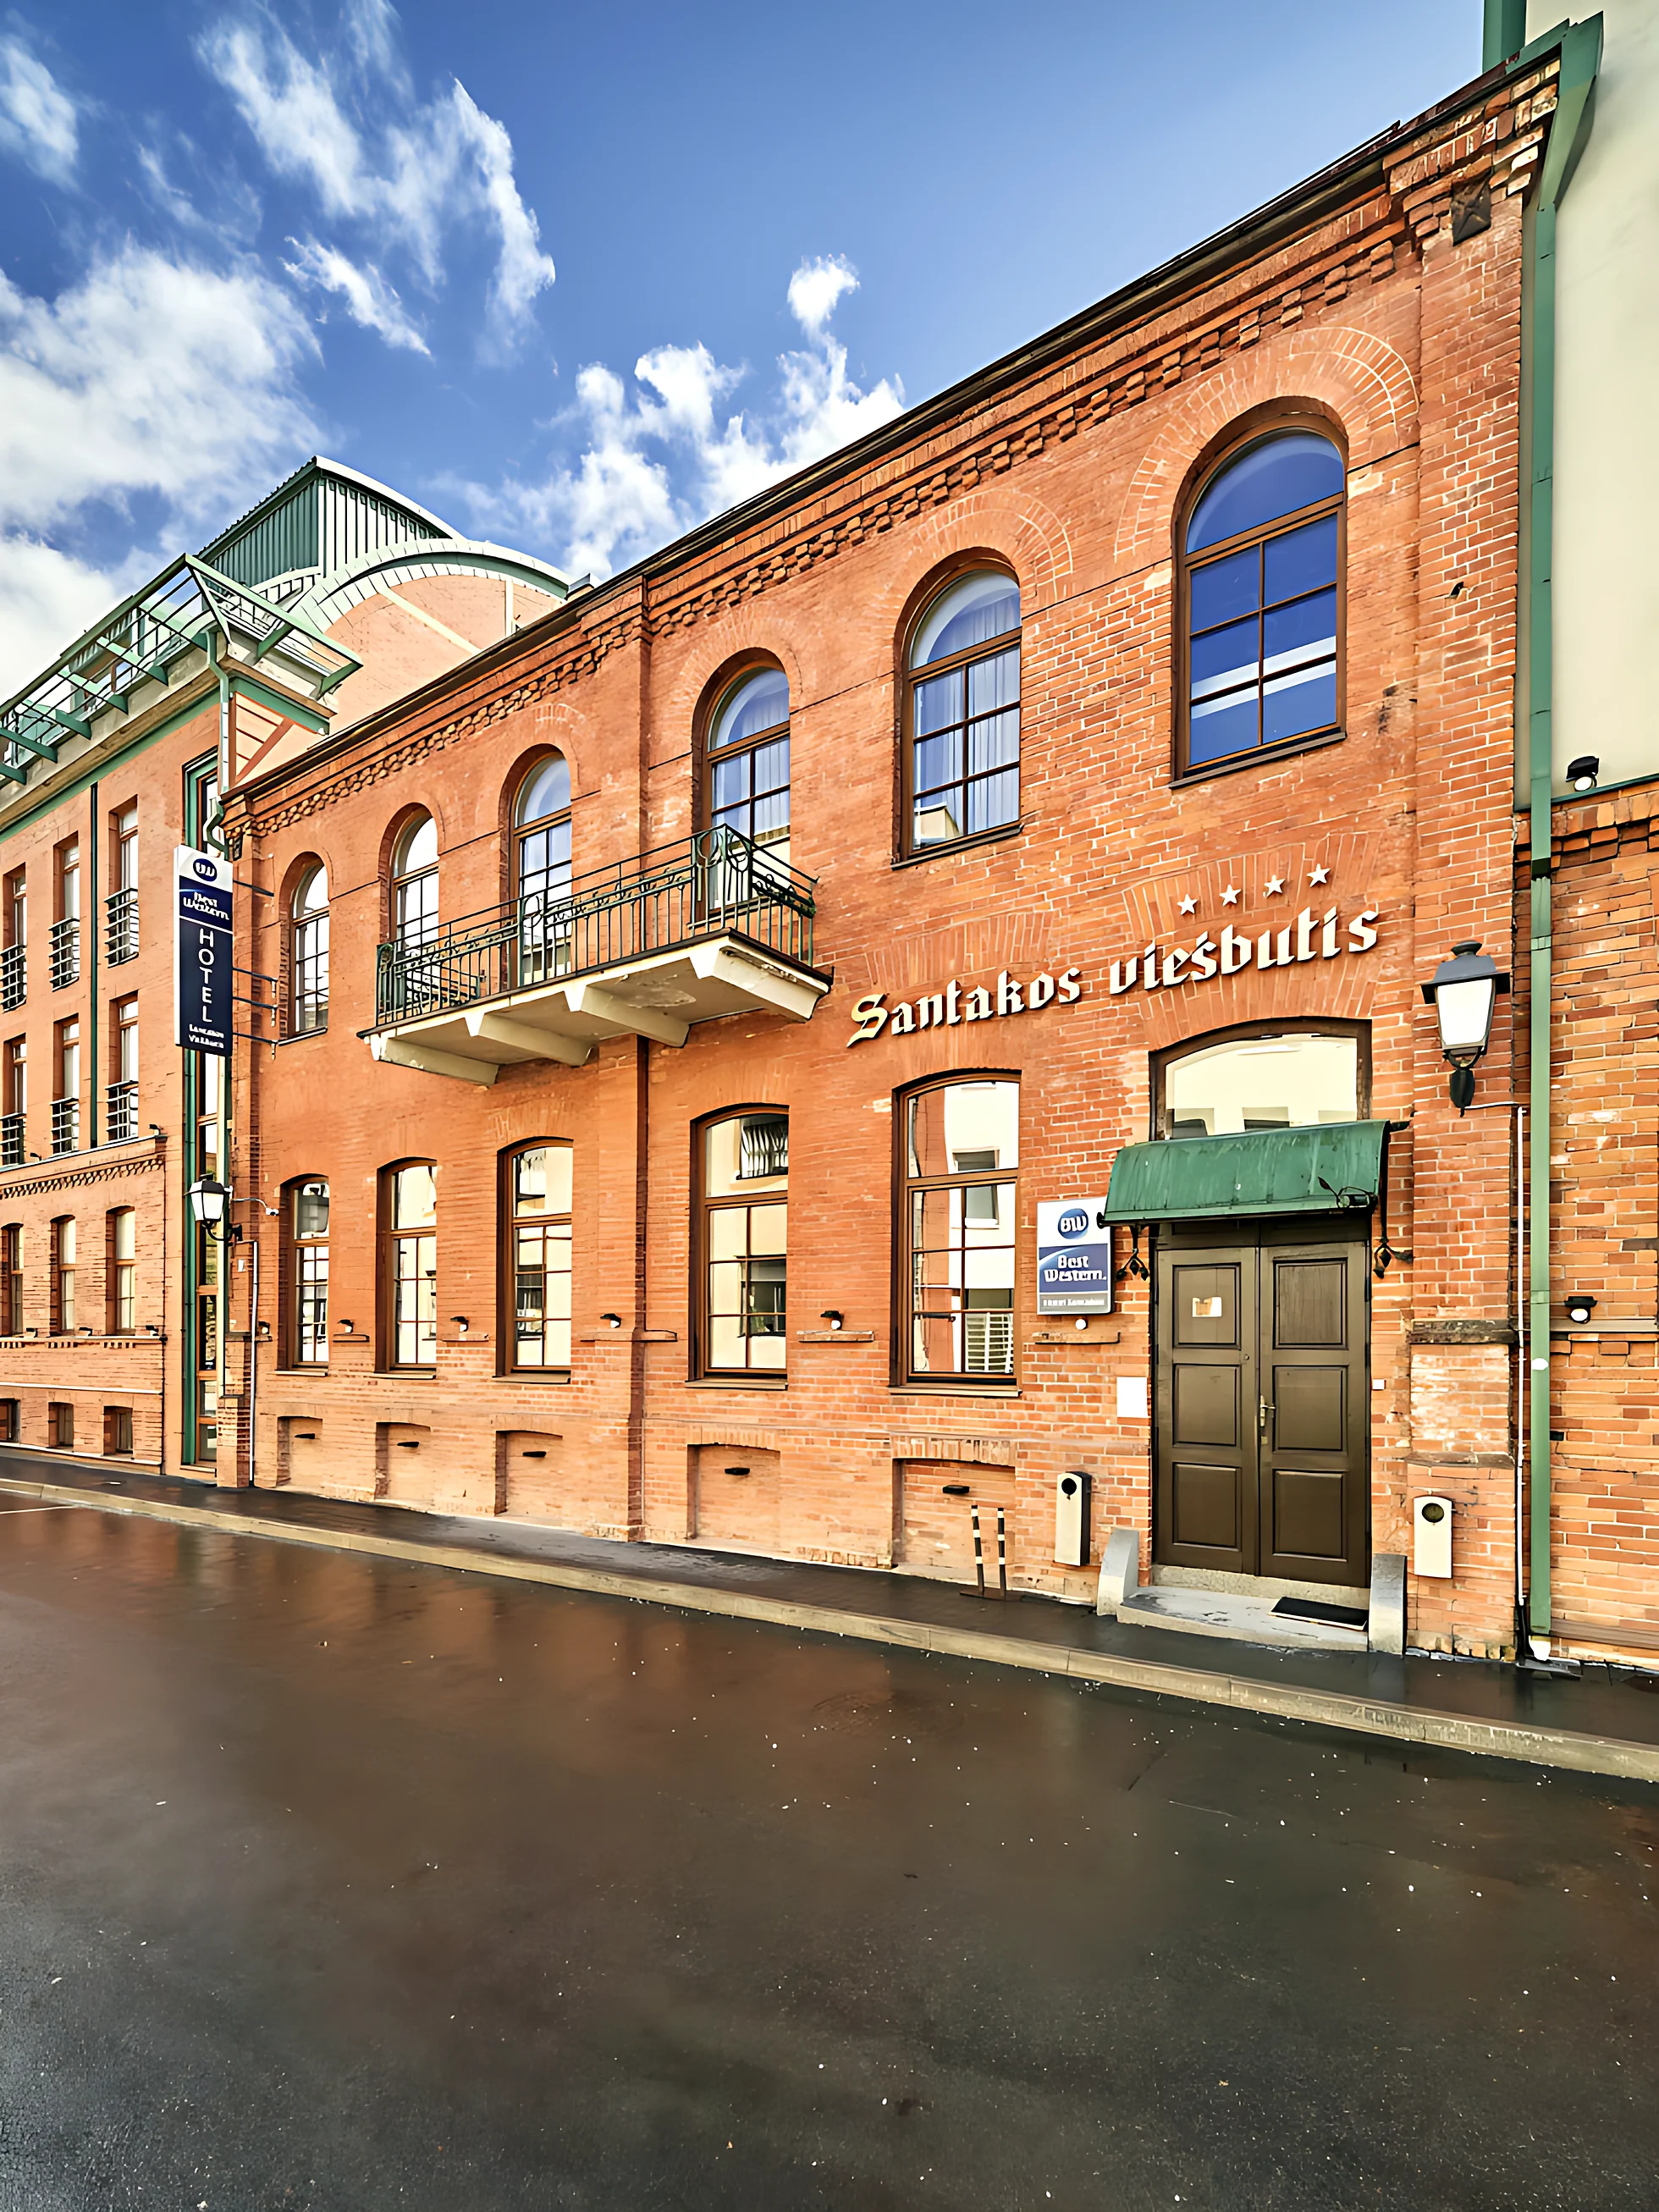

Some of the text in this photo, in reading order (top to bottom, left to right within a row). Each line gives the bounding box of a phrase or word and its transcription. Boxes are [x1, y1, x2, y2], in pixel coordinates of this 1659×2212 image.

[198, 929, 215, 1023] HOTEL
[846, 968, 1081, 1047] Santakos
[1058, 1255, 1089, 1269] Best
